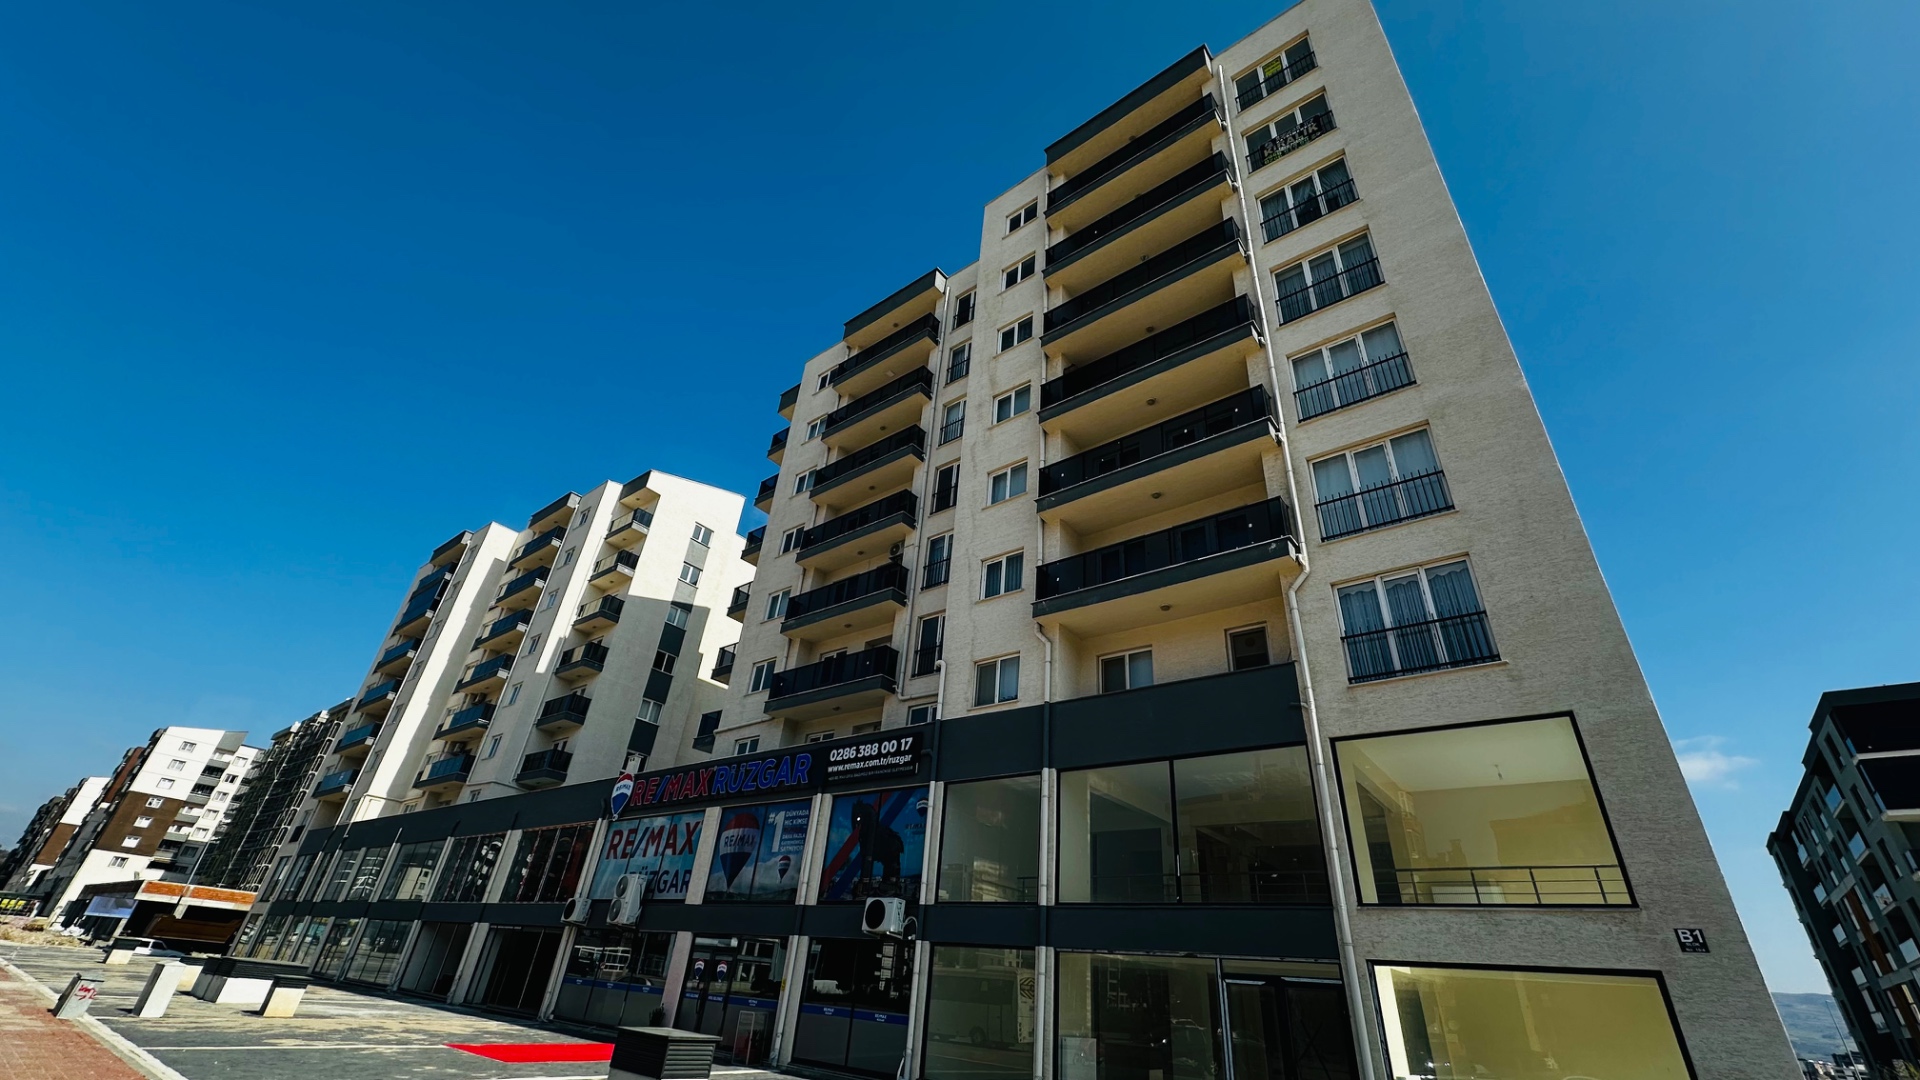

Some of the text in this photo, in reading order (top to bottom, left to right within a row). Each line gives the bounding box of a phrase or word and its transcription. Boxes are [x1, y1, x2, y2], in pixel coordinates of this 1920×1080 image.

[829, 737, 913, 762] 0286 388 00 17
[827, 754, 913, 773] www.remax.com.tr/ruzgar
[631, 768, 713, 806] RE/MAX
[712, 753, 811, 794] RÜZGAR
[606, 822, 701, 859] RE/MAX
[629, 867, 691, 893] ZGAR
[1677, 929, 1703, 943] B1
